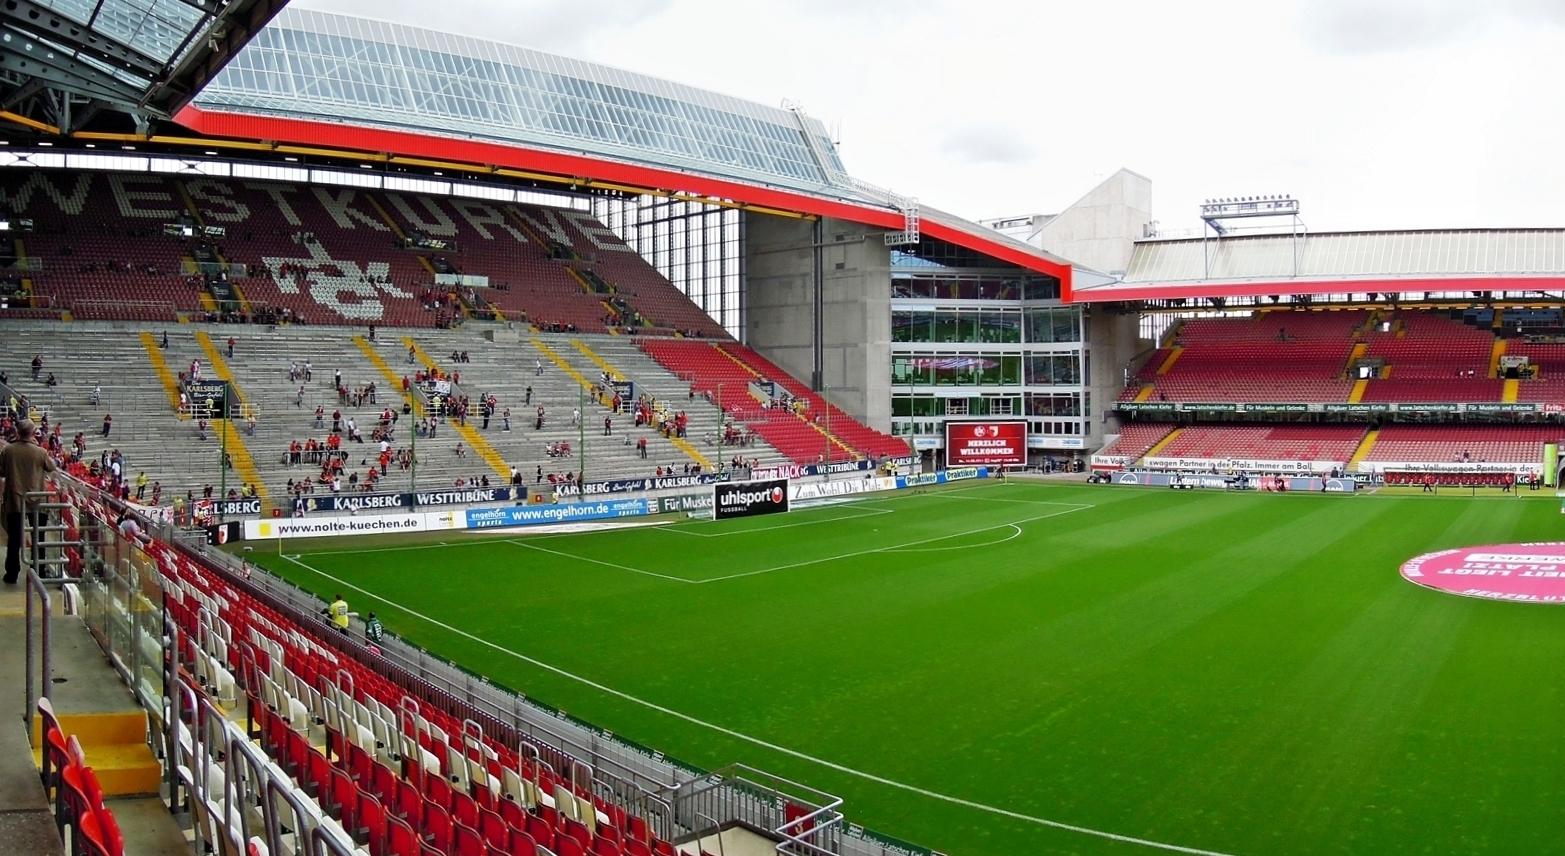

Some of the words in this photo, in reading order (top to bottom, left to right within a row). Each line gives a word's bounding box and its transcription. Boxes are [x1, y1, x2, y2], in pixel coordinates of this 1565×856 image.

[0, 172, 637, 252] WESTKURVE
[186, 384, 224, 392] KARLSBERG
[816, 461, 859, 475] WESTTRIBÜNE
[1180, 459, 1206, 468] Partner
[1255, 462, 1280, 470] Immer
[907, 474, 937, 486] Praktiker
[946, 469, 977, 480] Praktiker
[556, 481, 610, 496] KARLSBERG
[655, 475, 702, 489] KARLSBERG
[417, 489, 495, 505] WESTTRIBÜNE
[795, 486, 816, 499] Zum
[844, 481, 859, 494] Die
[665, 498, 680, 510] Für
[721, 490, 771, 506] uhlsport
[471, 509, 506, 520] engelhorn
[512, 501, 609, 520] www.engelhorn.de
[279, 518, 418, 535] www.nolte-kuechen.de
[1438, 568, 1514, 577] LIEGT
